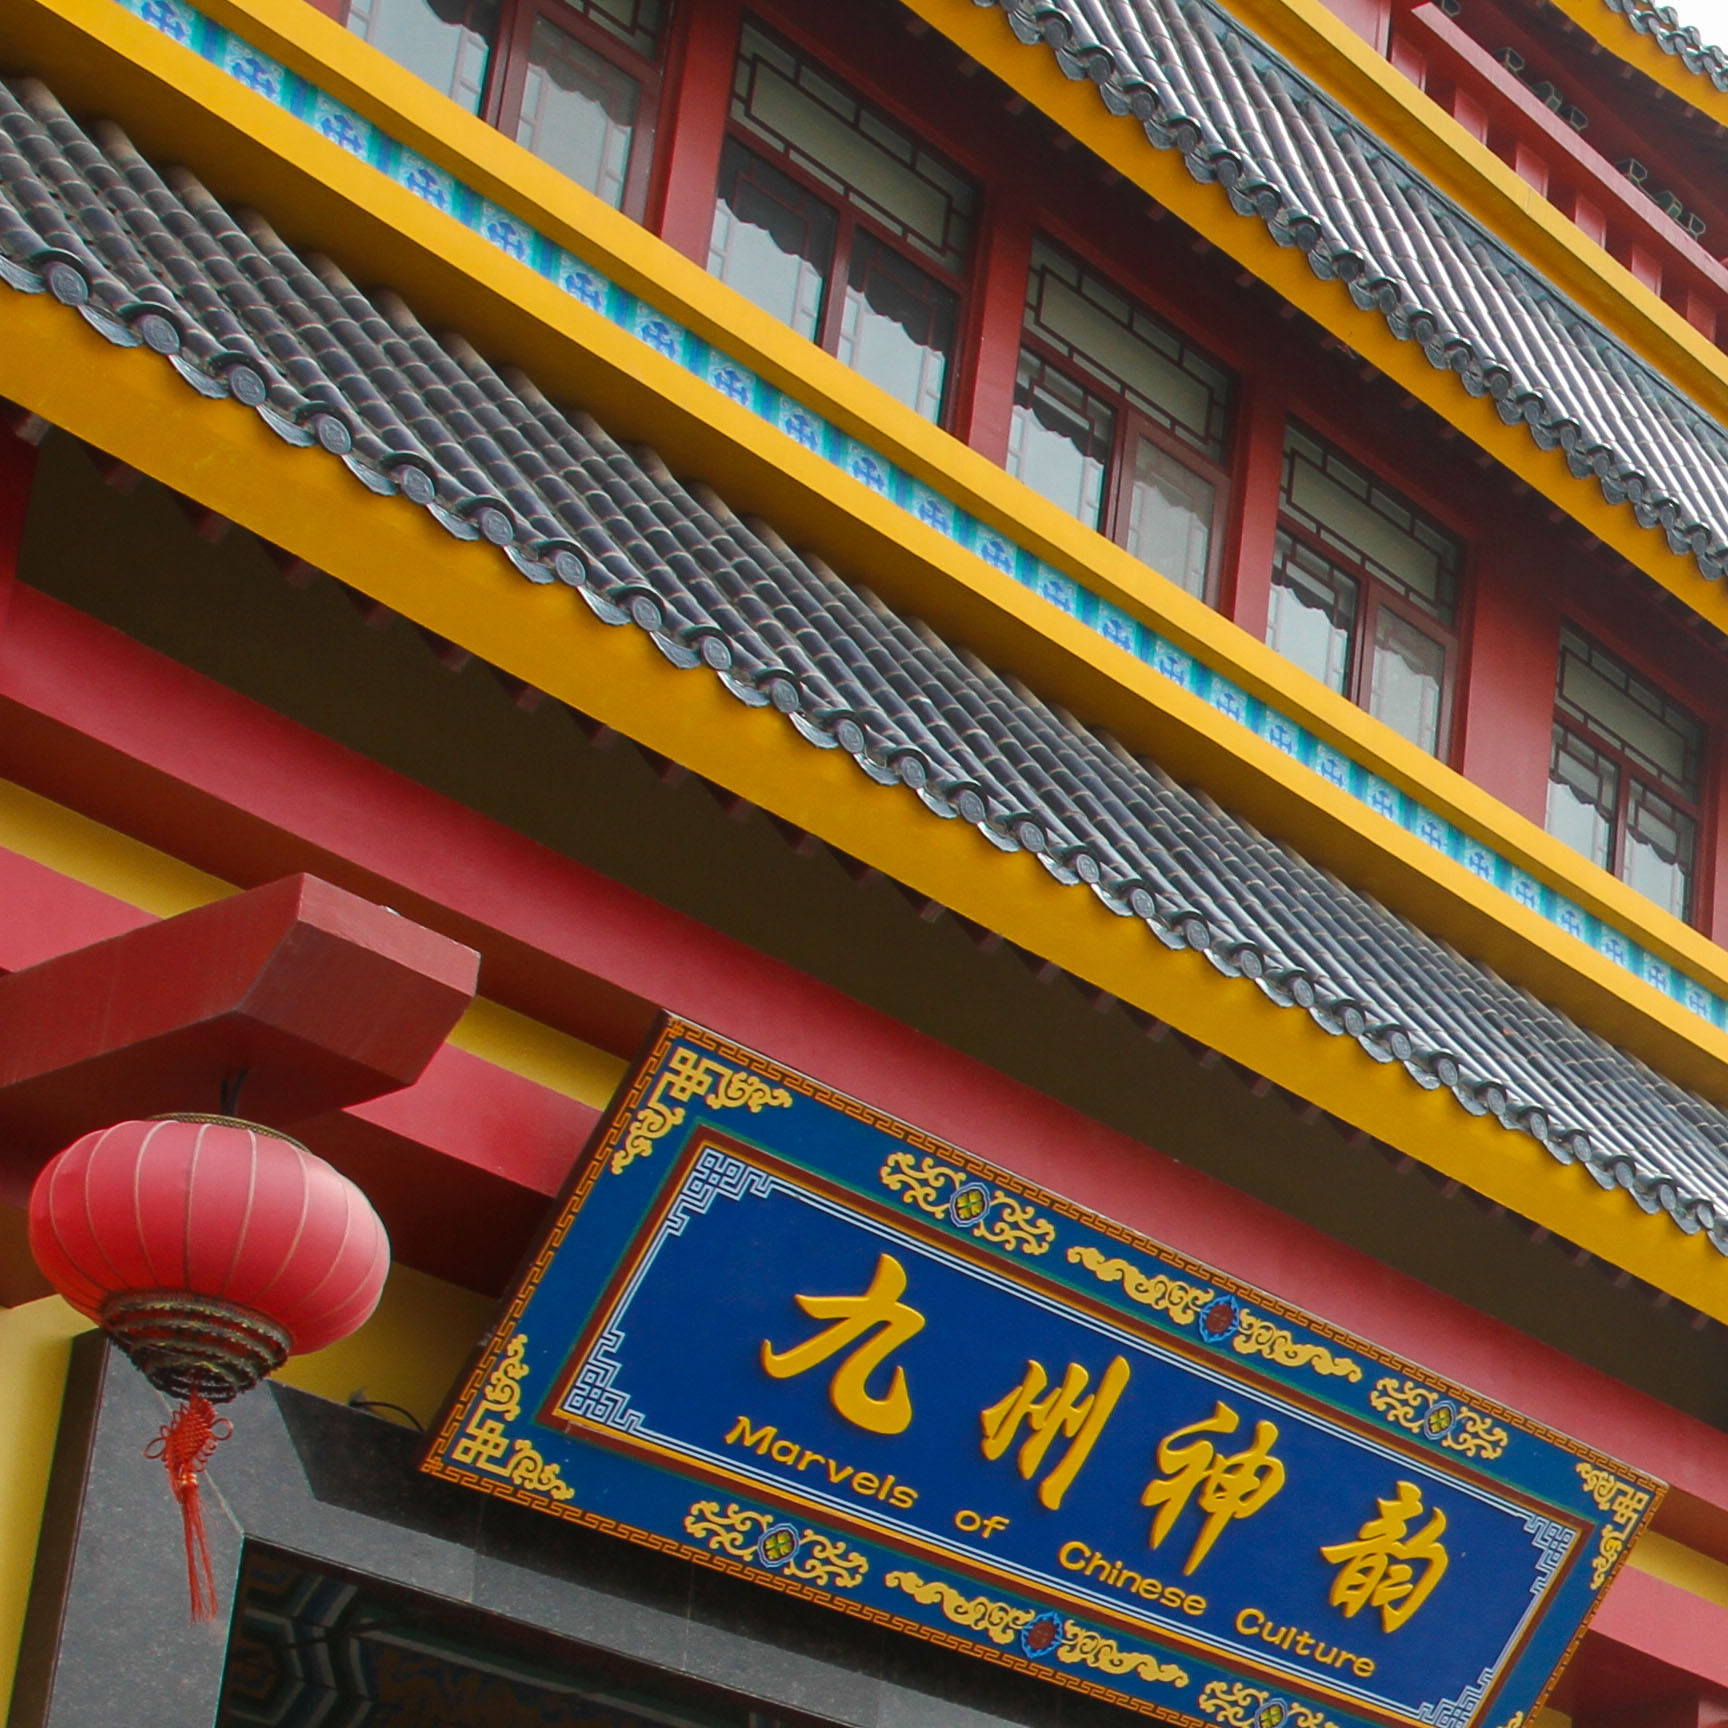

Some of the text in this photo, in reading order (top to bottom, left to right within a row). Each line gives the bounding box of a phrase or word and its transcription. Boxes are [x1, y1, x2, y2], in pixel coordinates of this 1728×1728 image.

[723, 1414, 1376, 1679] Marvels of Chinese Culture
[760, 1252, 1450, 1635] 九州神韵
